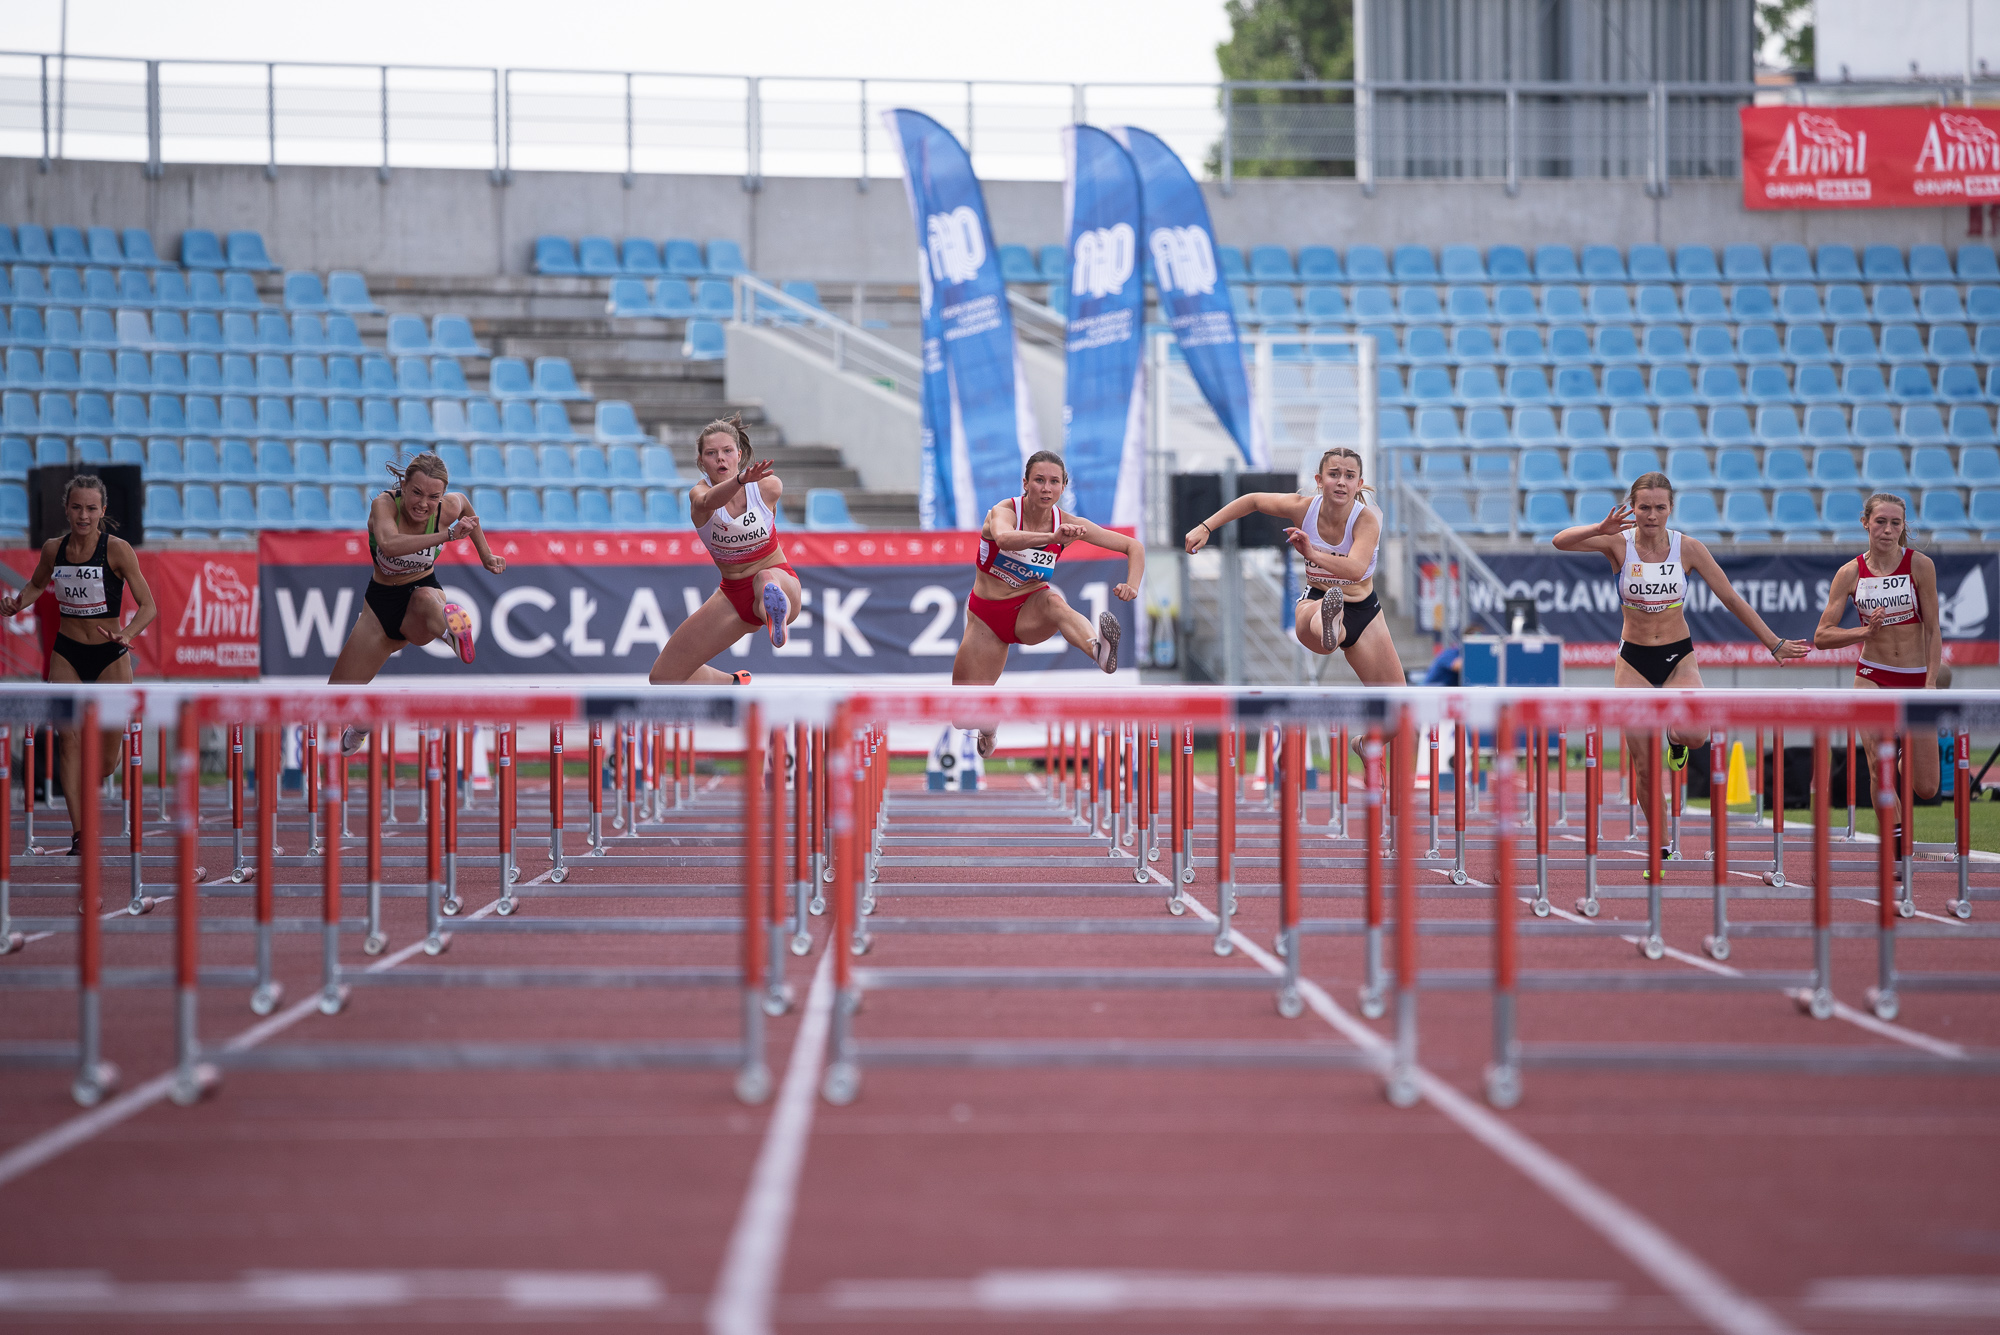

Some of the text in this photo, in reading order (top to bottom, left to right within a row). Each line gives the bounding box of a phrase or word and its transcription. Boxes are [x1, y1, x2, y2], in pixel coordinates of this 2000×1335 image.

[1767, 121, 1867, 176] Anwil
[1914, 120, 2000, 174] Anwi
[1765, 182, 1816, 199] GRUPA
[743, 511, 757, 527] 68
[712, 526, 767, 544] RUGOWSKA
[548, 539, 808, 556] MISTRZOA
[833, 539, 965, 557] POLSKI
[1031, 552, 1053, 566] 329
[76, 568, 100, 580] 461
[1003, 559, 1045, 580] ZEGAN
[1659, 564, 1675, 576] 17
[993, 569, 1020, 588] WŁOCŁAW
[1883, 576, 1907, 590] 507
[65, 587, 88, 598] RAK
[1468, 578, 1623, 614] WOCŁAW
[1629, 583, 1678, 595] OLSZAK
[1858, 594, 1911, 610] ANTONOWICZ
[274, 585, 876, 659] WOCŁAEK
[908, 582, 1109, 657] 21
